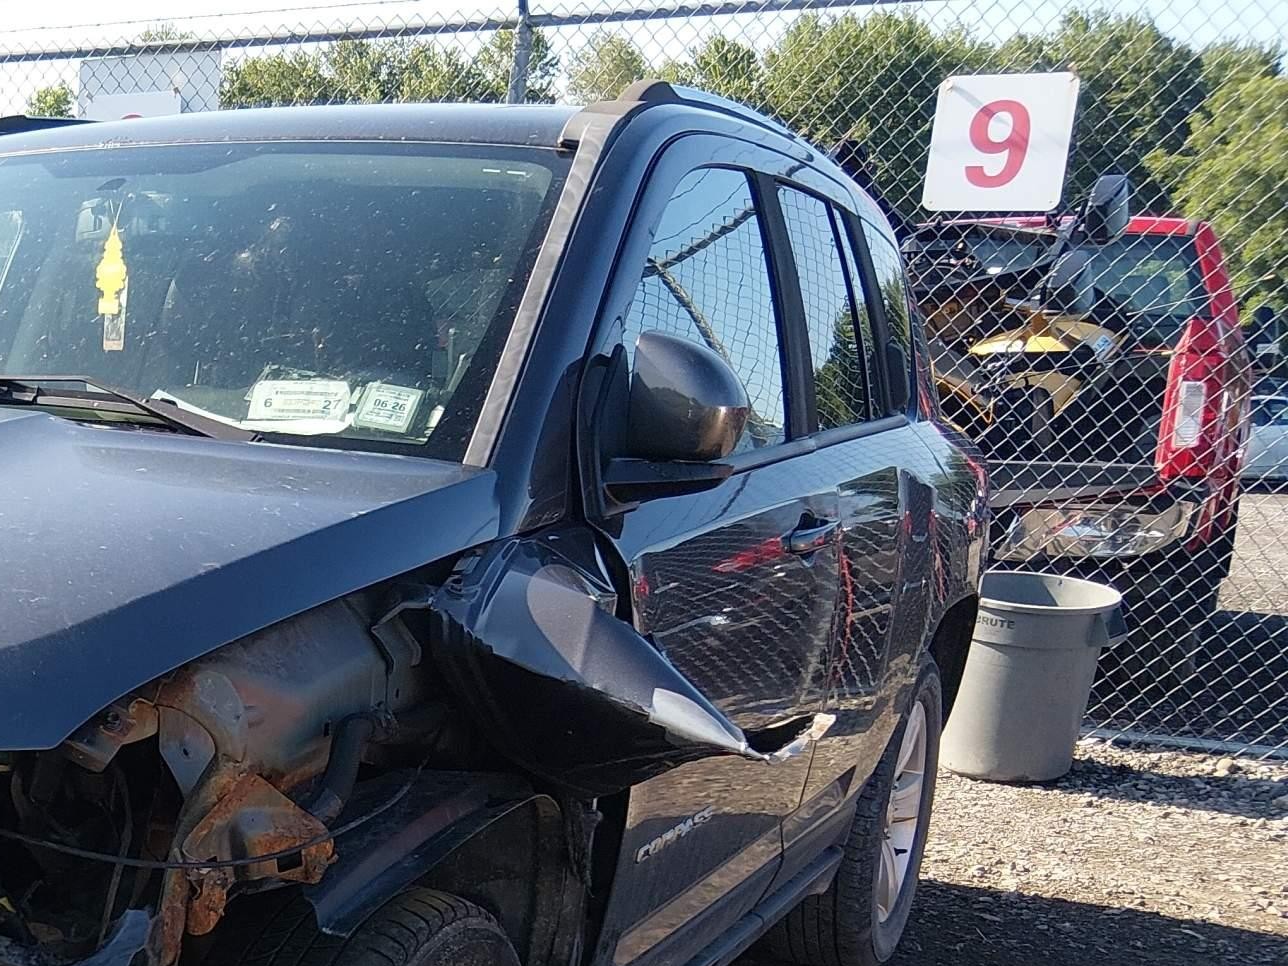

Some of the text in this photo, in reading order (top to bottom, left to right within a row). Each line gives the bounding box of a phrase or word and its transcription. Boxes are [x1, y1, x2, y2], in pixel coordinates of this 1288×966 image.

[963, 98, 1031, 189] 9
[263, 398, 273, 408] 6
[322, 399, 342, 411] 27
[635, 804, 714, 864] COMPASS
